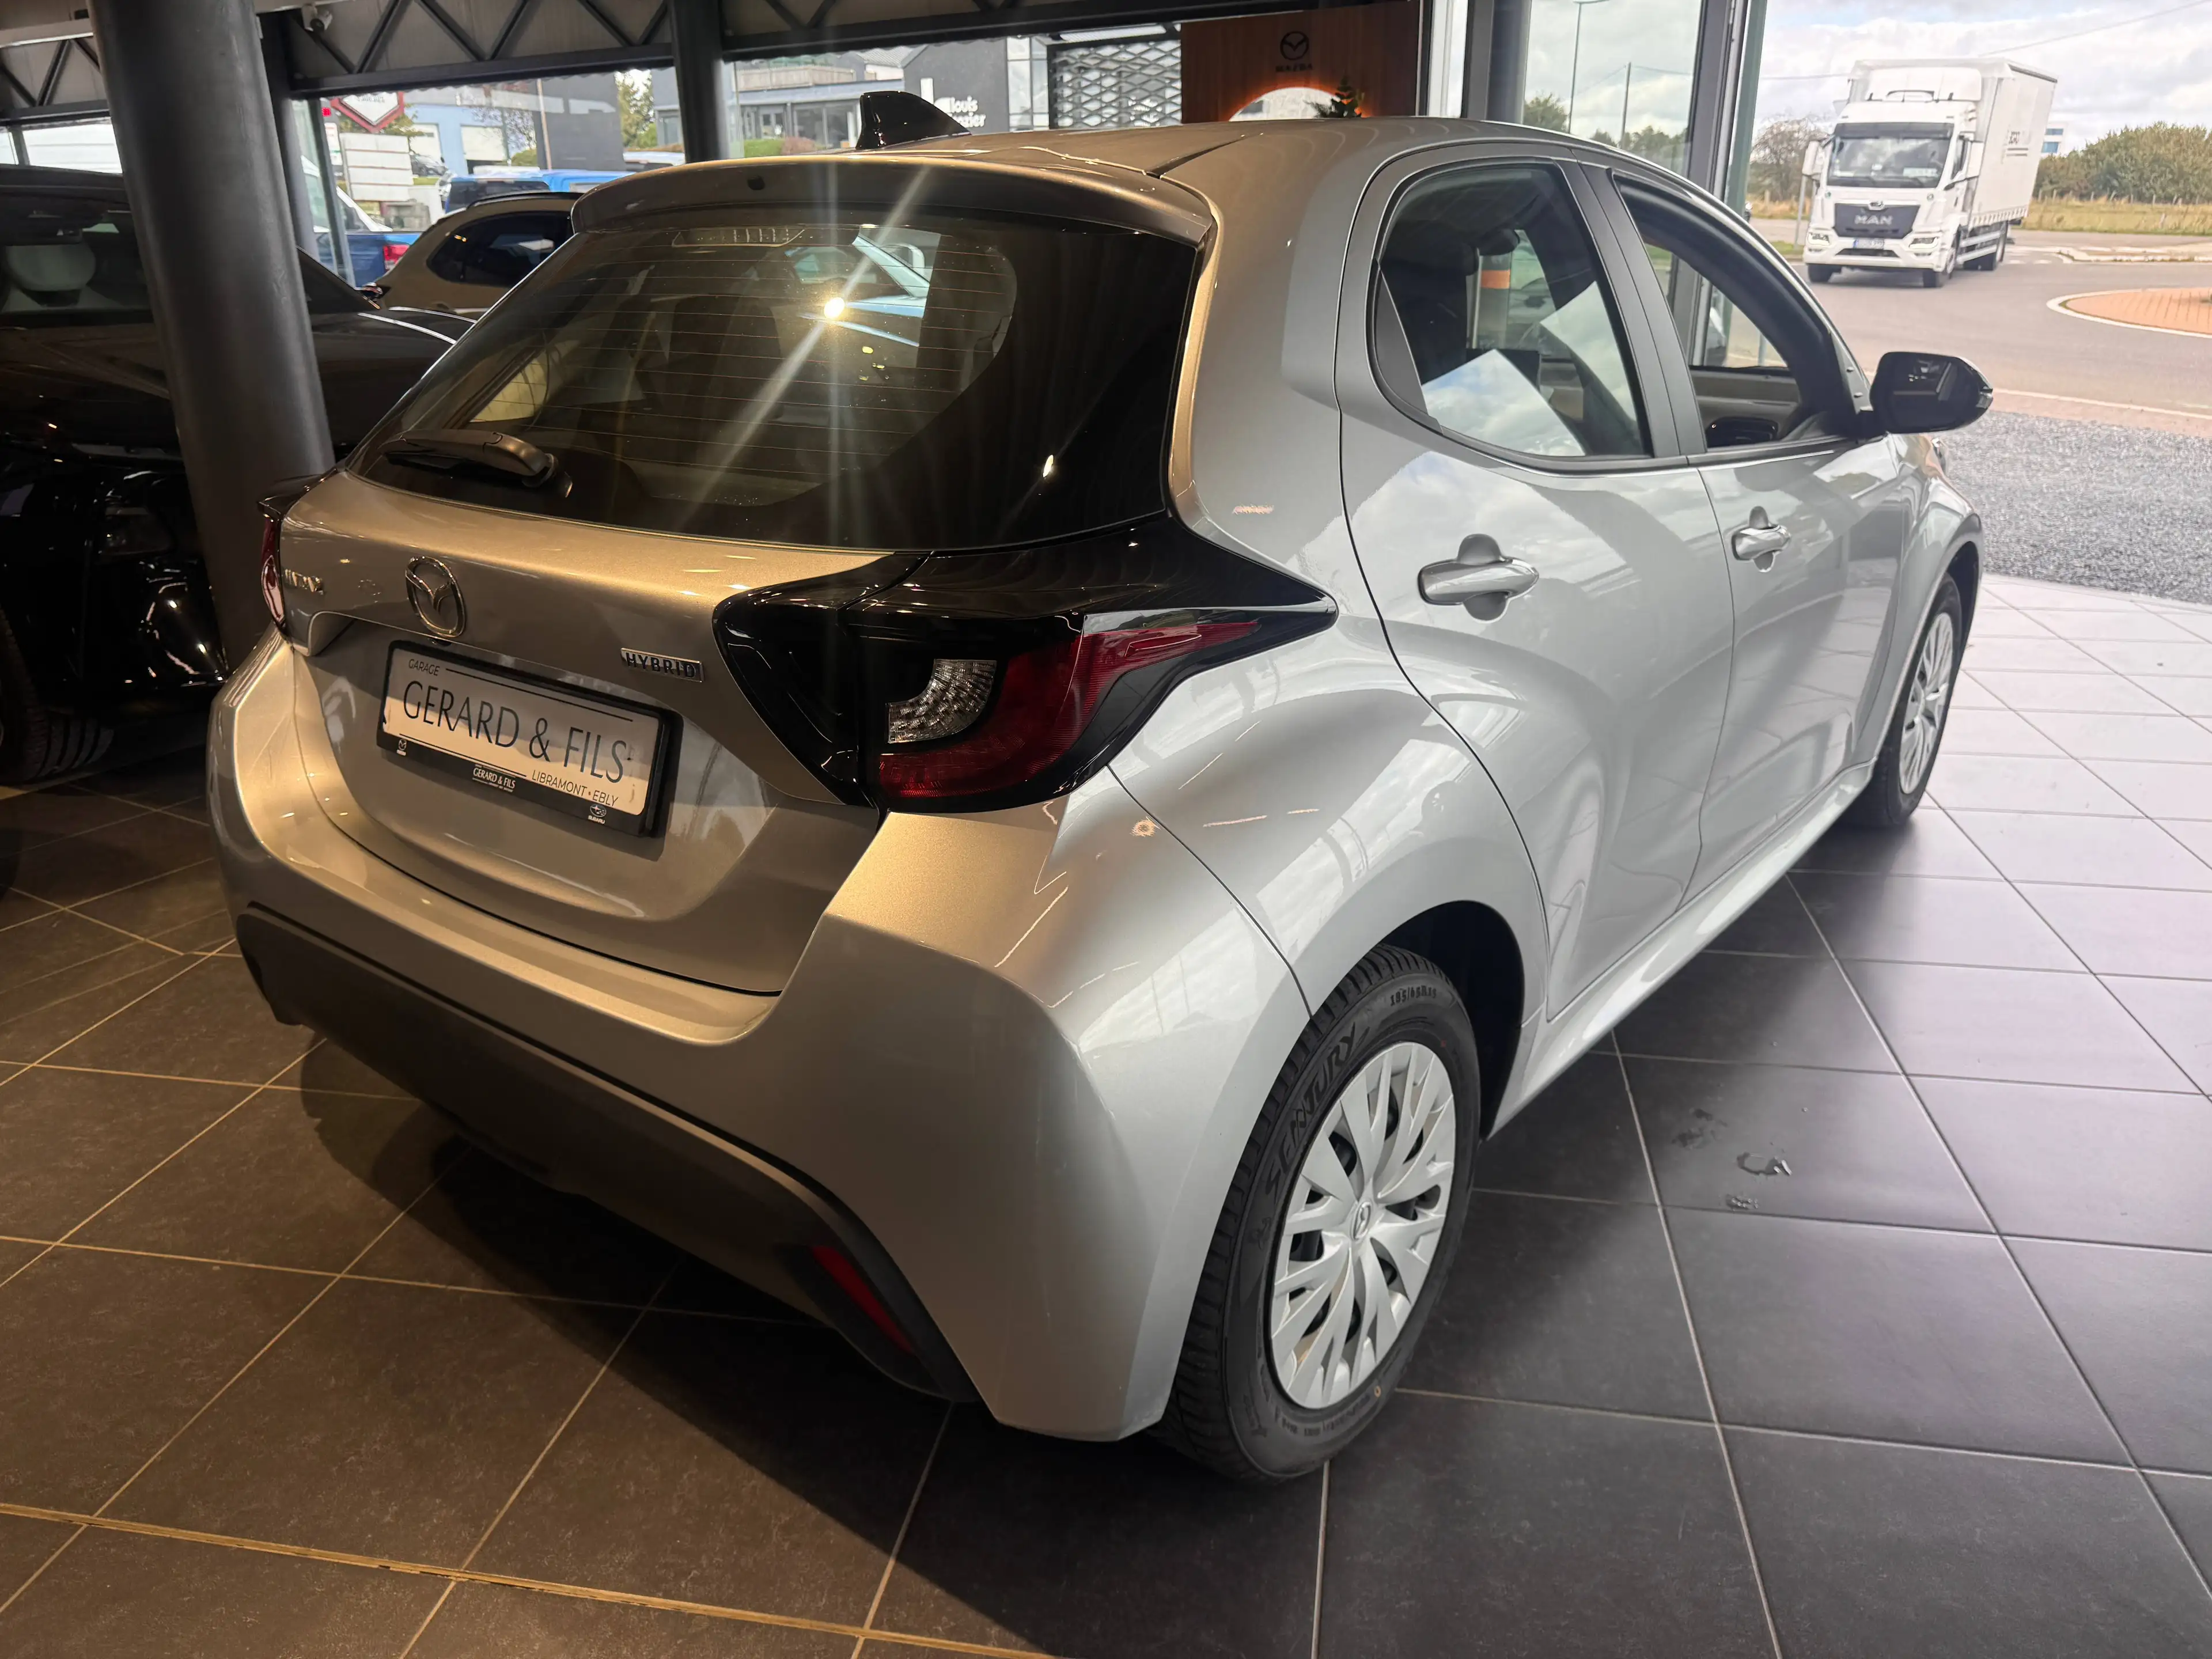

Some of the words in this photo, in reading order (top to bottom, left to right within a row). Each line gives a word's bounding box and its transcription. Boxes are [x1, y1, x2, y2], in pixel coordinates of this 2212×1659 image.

[1854, 215, 1893, 225] MAN
[408, 658, 440, 676] GARAGE
[626, 652, 696, 678] HYBRID
[403, 680, 519, 748] GERARD
[529, 718, 551, 762] &
[563, 726, 627, 783] FILS
[473, 767, 497, 782] GERARD
[498, 776, 503, 785] &
[503, 777, 516, 789] FILS
[532, 769, 588, 797] LIBRAMONT
[592, 790, 619, 806] EBLY
